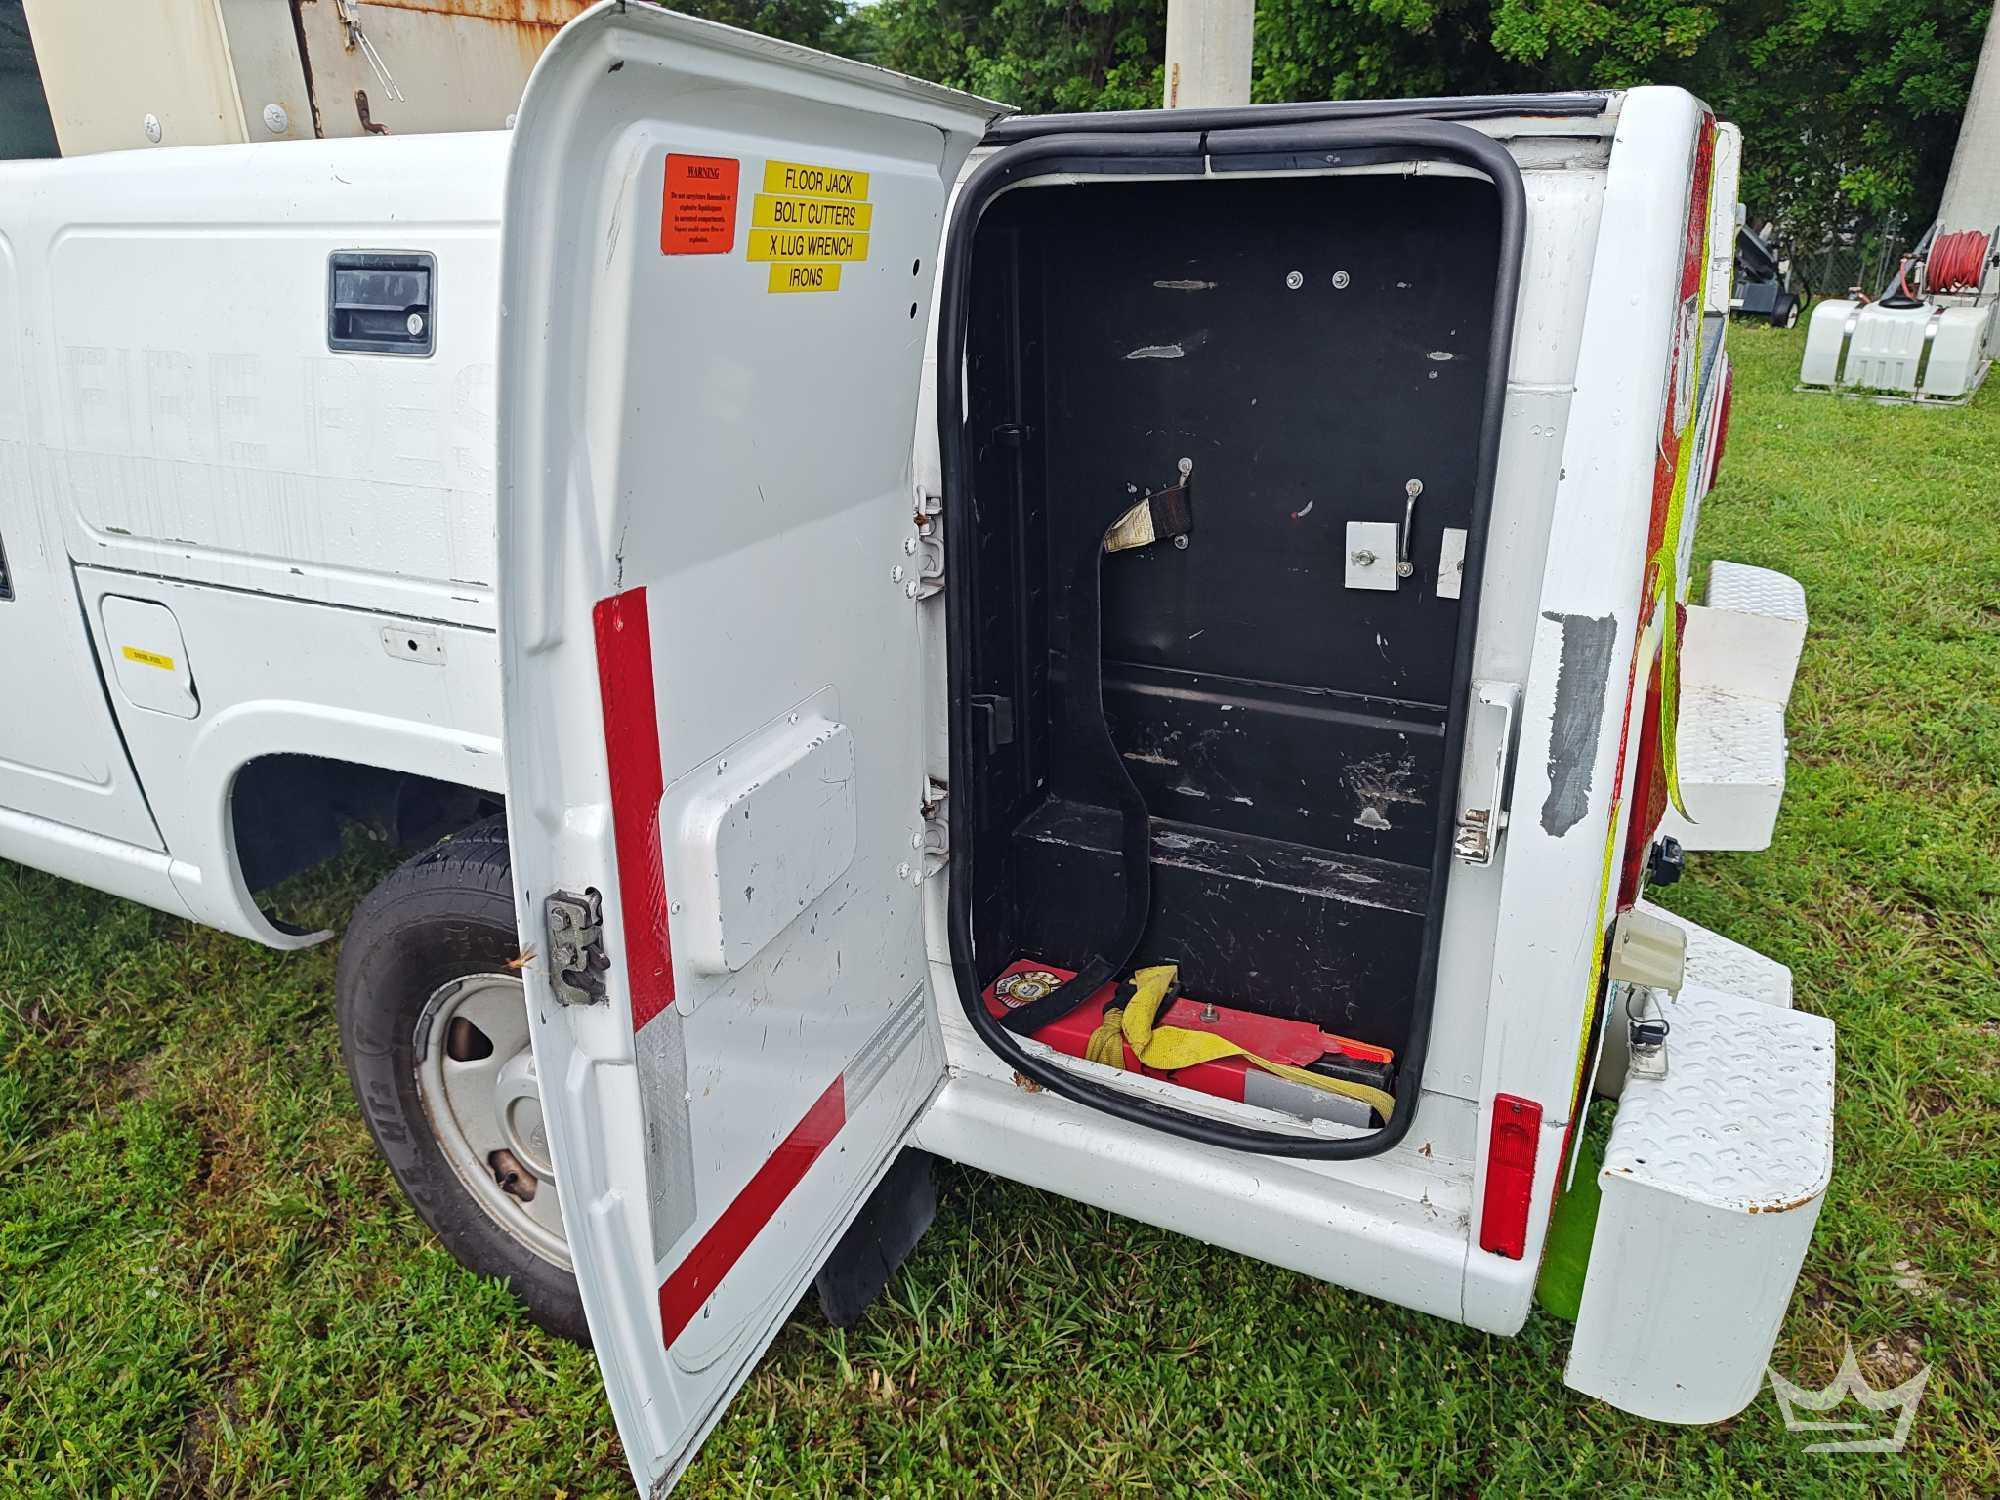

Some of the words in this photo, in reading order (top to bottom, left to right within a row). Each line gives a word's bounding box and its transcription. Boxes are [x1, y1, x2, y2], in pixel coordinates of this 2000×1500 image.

[687, 166, 720, 179] WARNING
[785, 168, 824, 191] FLOOR
[826, 174, 853, 194] JACK
[774, 201, 806, 223] BOLT
[808, 204, 856, 226] CUTTERS
[770, 235, 778, 255] X
[780, 235, 805, 255] LUG
[808, 236, 854, 256] WRENCH
[789, 268, 824, 287] IRONS
